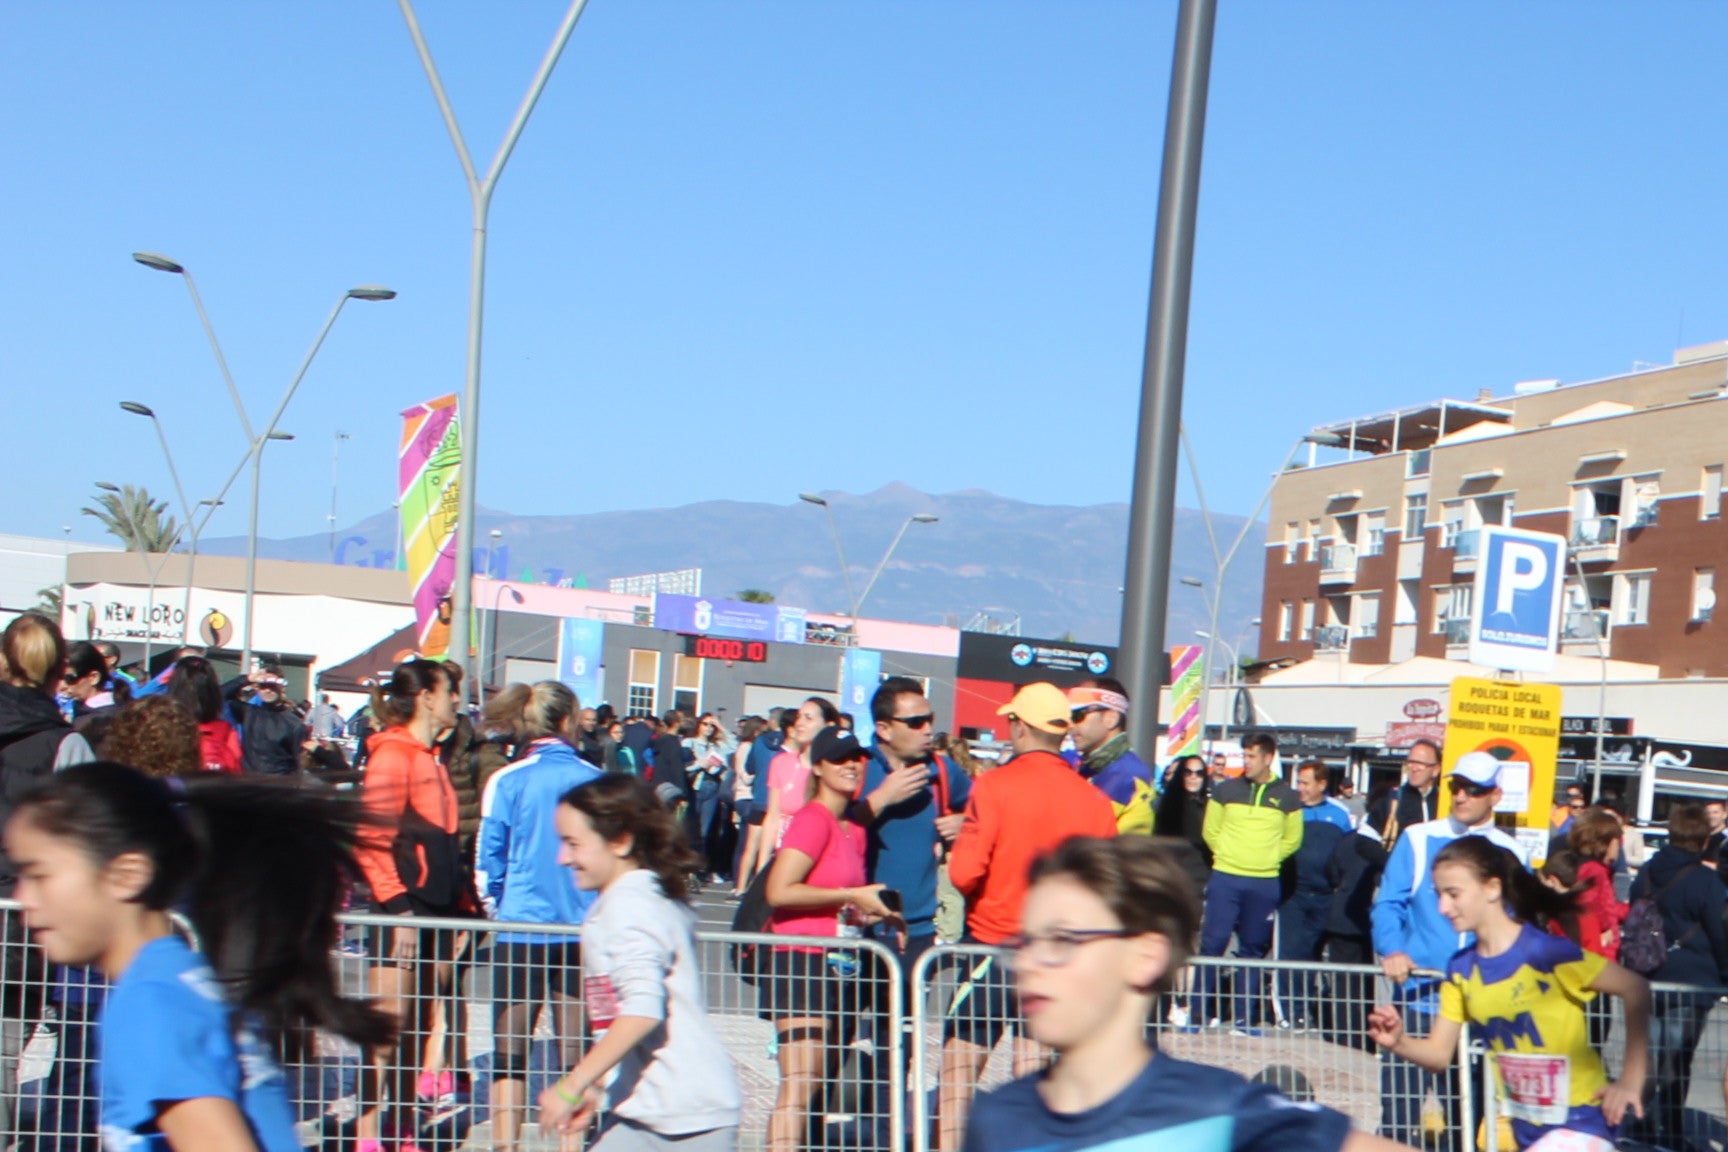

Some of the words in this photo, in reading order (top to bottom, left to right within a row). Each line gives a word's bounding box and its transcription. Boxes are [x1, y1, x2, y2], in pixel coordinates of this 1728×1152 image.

[1496, 541, 1548, 613] P
[104, 605, 135, 621] NEW
[142, 607, 185, 626] LORO
[1470, 687, 1508, 700] POLICIA
[1513, 692, 1542, 704] LOCAL
[1458, 702, 1508, 716] ROQUETAS
[1513, 707, 1525, 718] DE
[1530, 709, 1550, 720] MAR
